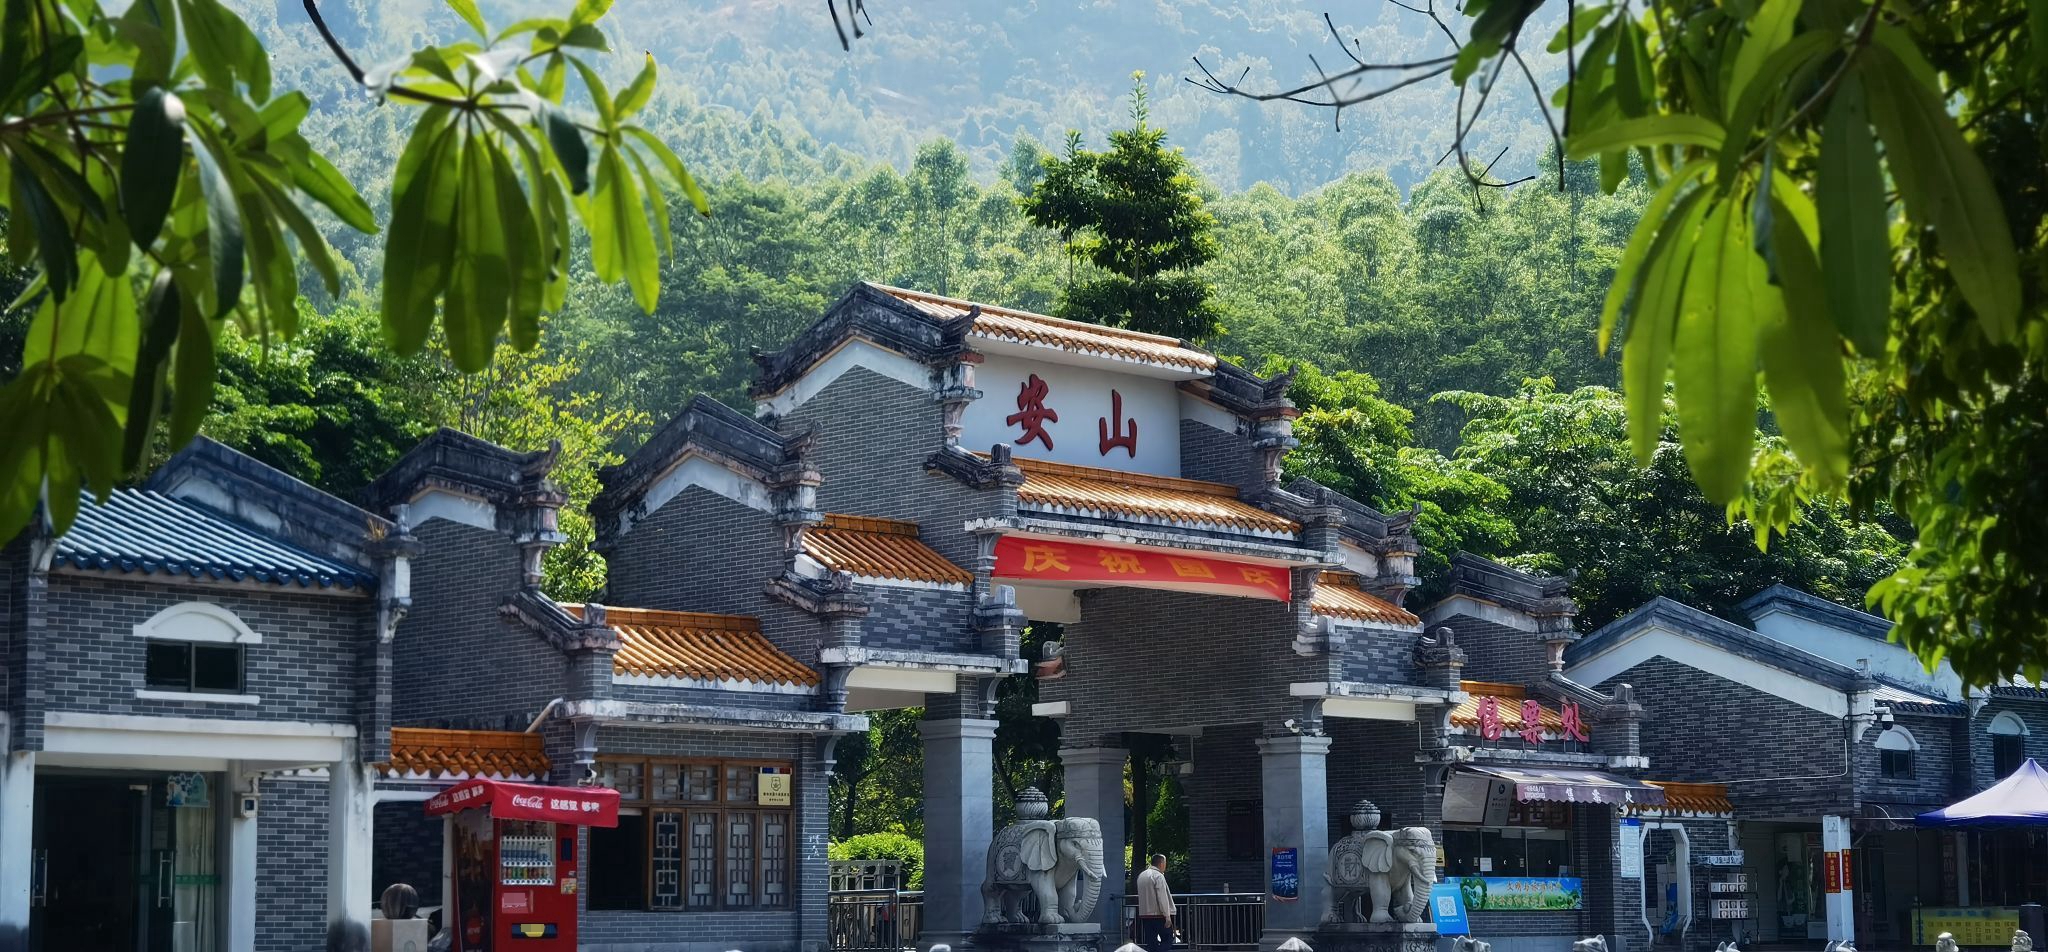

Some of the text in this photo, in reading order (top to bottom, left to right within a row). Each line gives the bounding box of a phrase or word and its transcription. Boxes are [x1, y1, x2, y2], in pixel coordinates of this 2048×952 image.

[1006, 373, 1138, 459] 安山
[1022, 546, 1280, 588] 庆祝国庆
[1476, 695, 1590, 745] 售票处
[1565, 787, 1635, 804] 售票处
